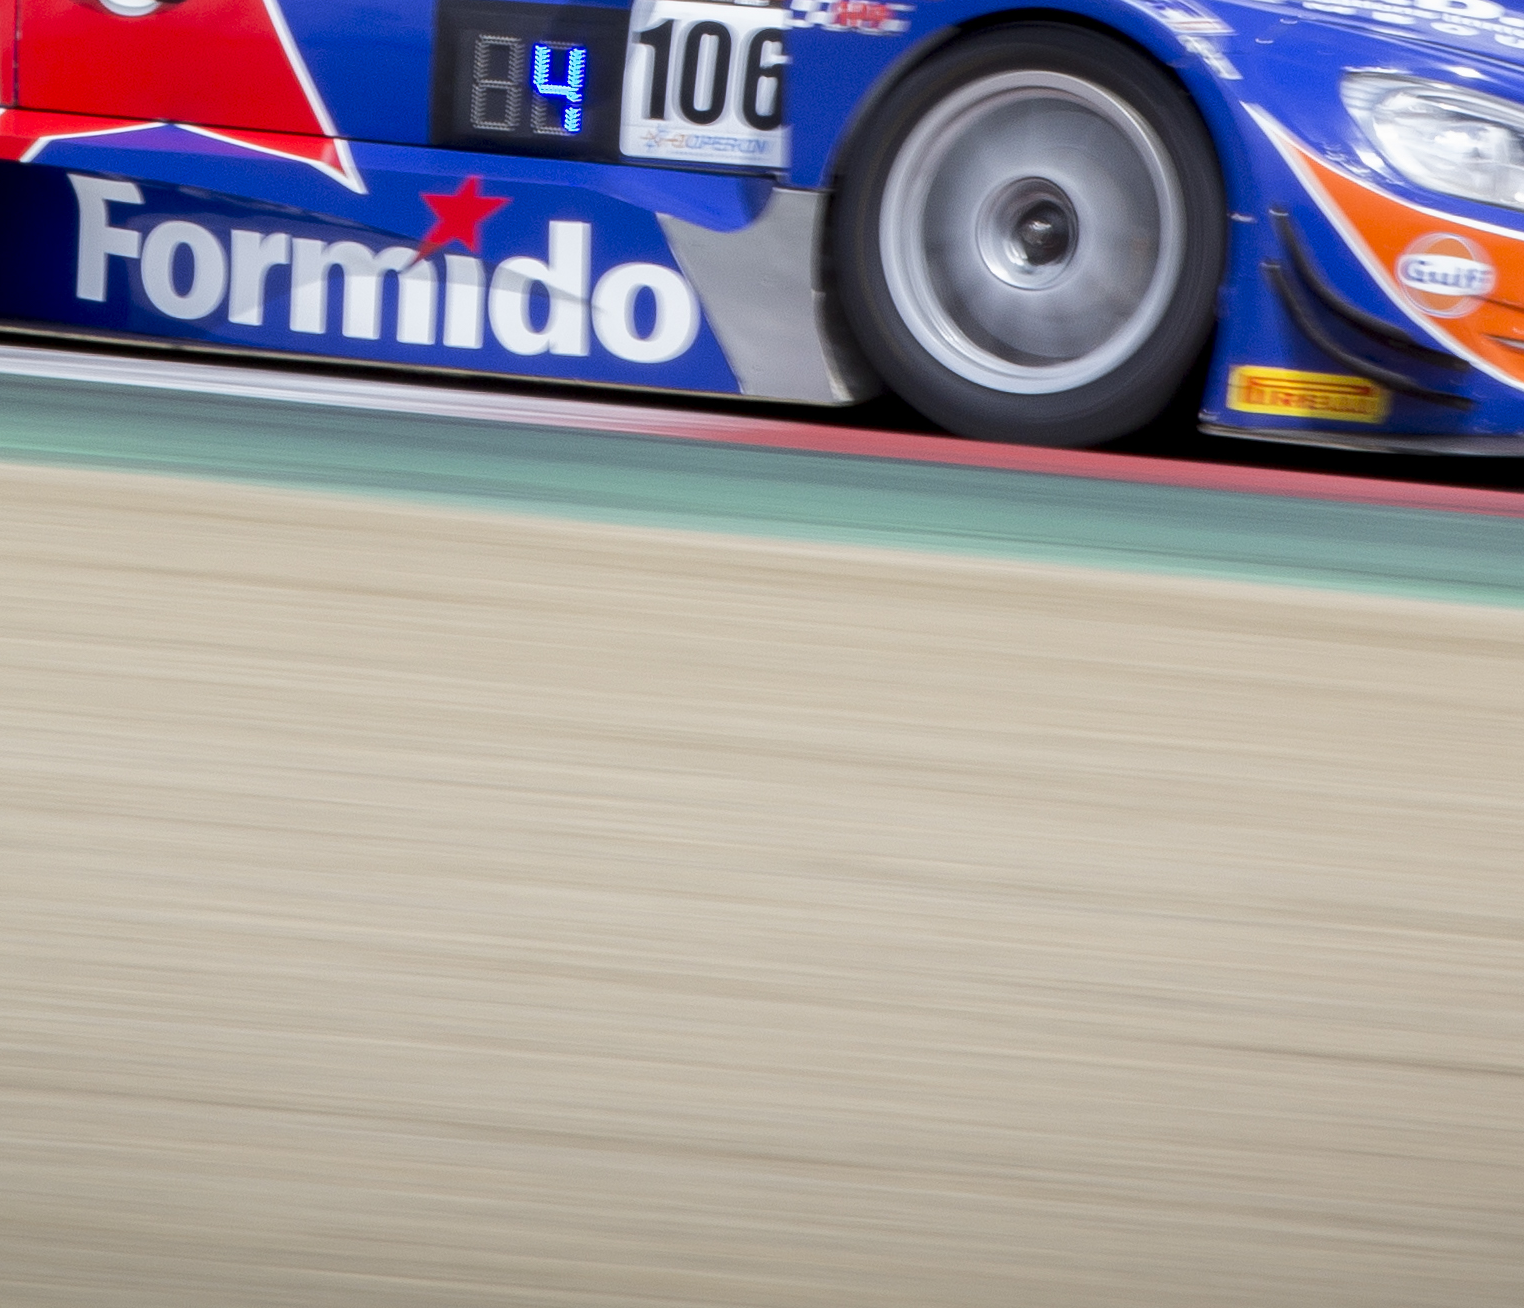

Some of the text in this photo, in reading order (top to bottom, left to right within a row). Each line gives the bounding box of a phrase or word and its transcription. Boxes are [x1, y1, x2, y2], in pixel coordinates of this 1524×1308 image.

[638, 19, 784, 131] 106
[68, 173, 700, 363] Formido
[1401, 258, 1490, 290] Gulf
